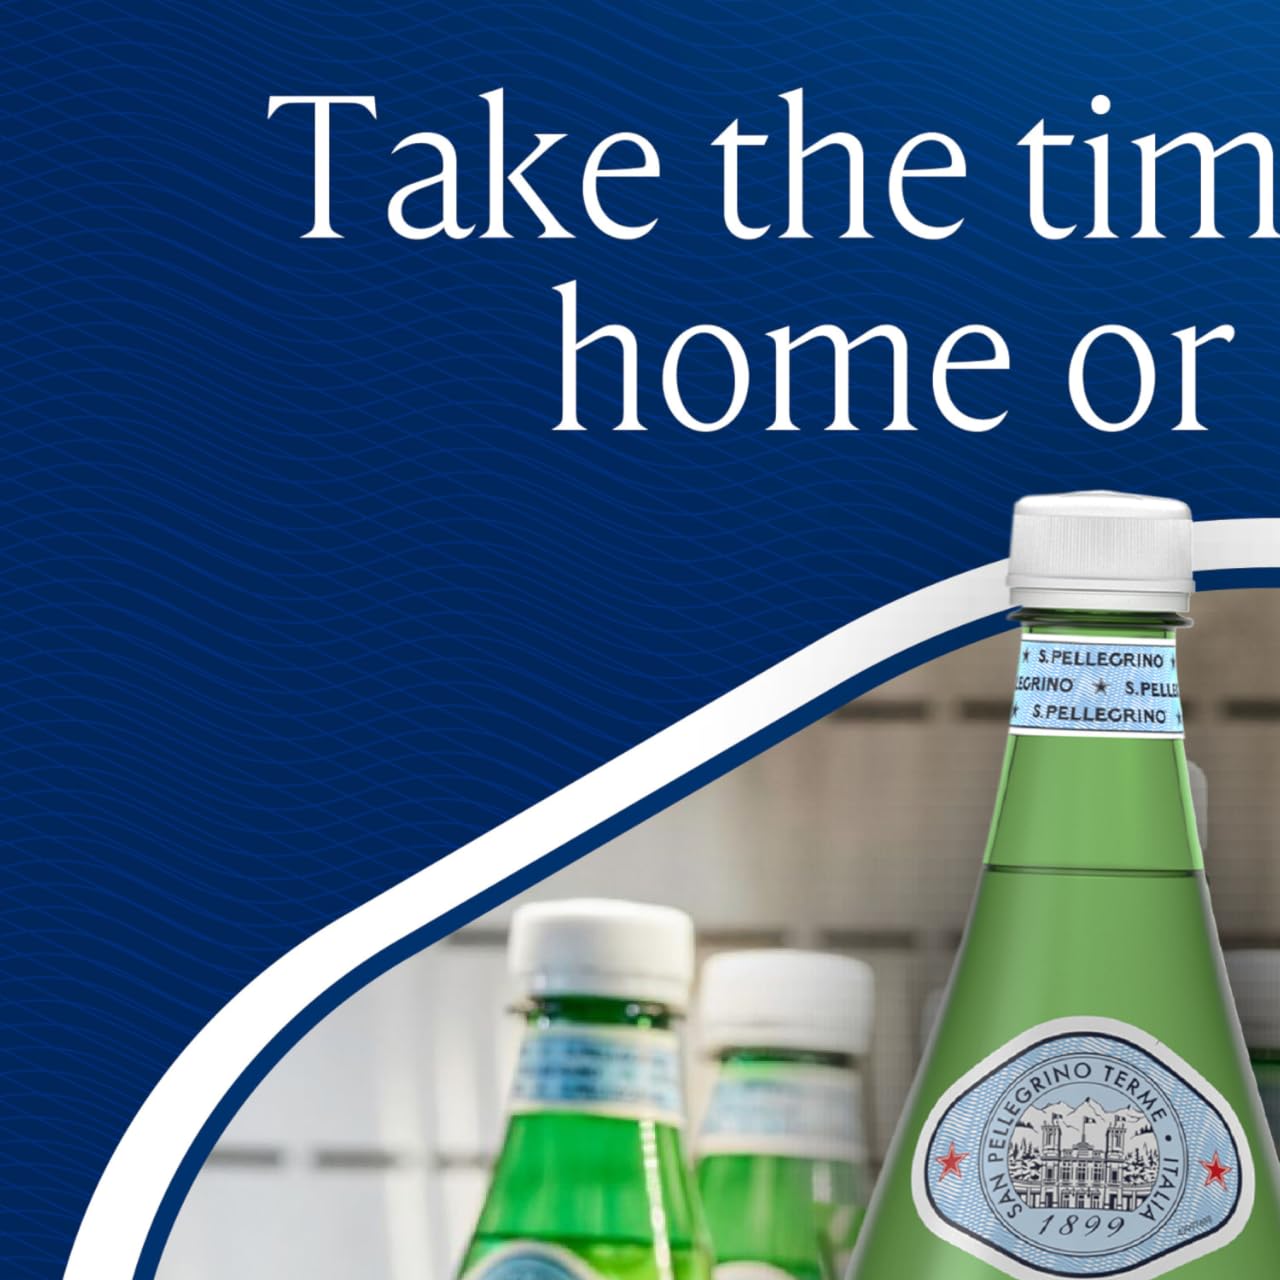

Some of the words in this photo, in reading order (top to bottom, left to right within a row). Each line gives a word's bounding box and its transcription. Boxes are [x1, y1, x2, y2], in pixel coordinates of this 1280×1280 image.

[1038, 649, 1164, 668] S.PELLEGRINO
[1032, 704, 1166, 724] S.PELLEGRINO
[987, 1062, 1092, 1164] PELLEGRINO
[1104, 1065, 1167, 1123] TERME
[989, 1172, 1023, 1219] SAN
[1140, 1157, 1179, 1221] ITALIA
[1038, 1213, 1125, 1238] 1899
